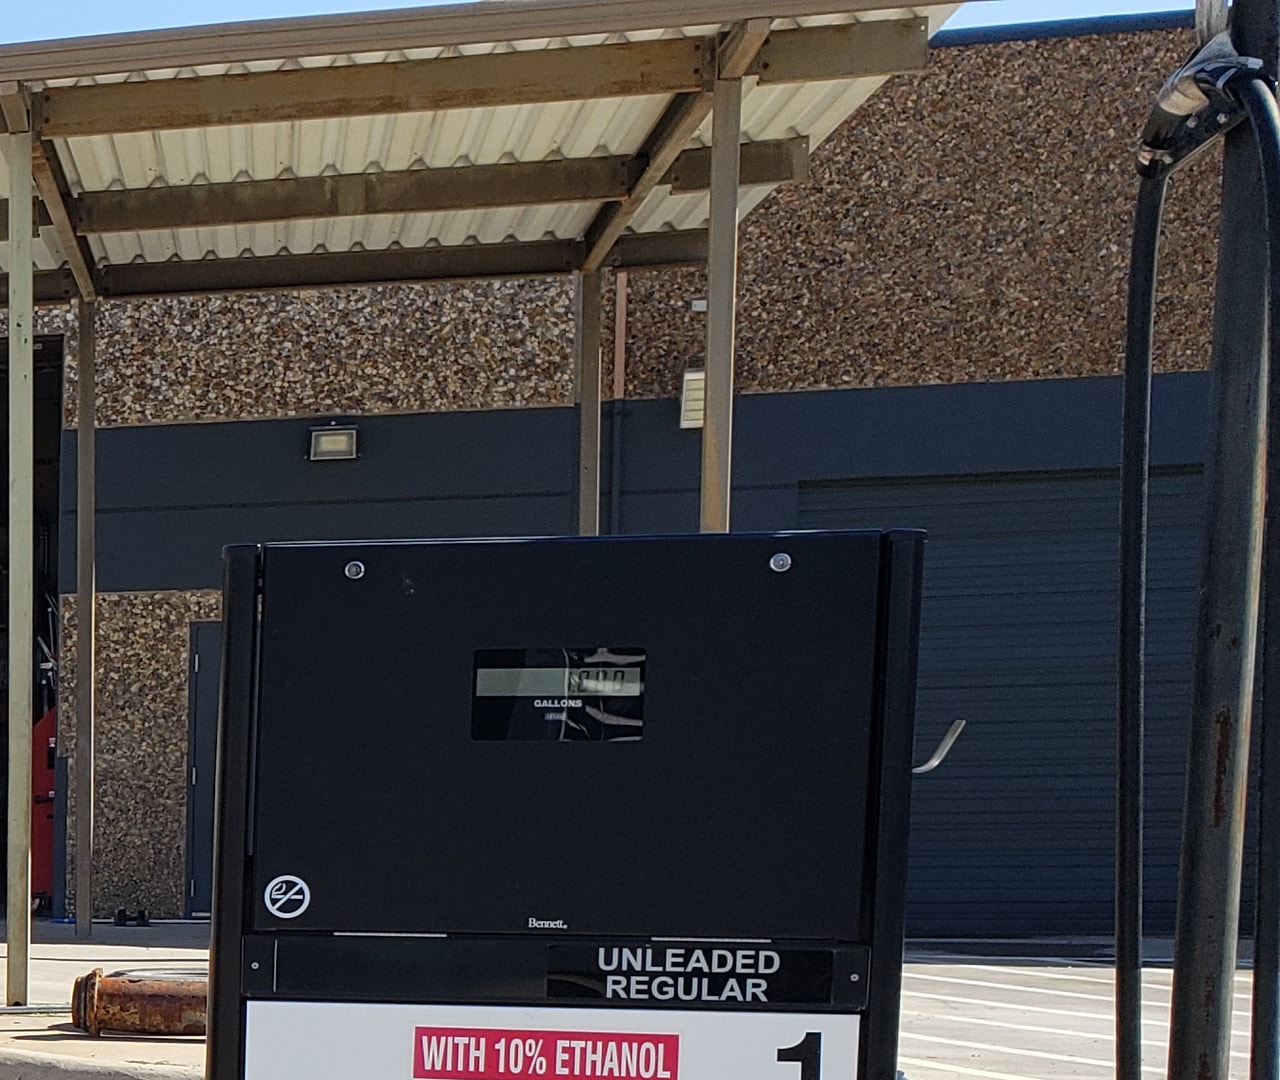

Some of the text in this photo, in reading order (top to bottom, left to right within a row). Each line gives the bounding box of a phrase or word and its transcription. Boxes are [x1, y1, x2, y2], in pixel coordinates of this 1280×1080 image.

[534, 699, 582, 708] GALLONS
[528, 918, 563, 928] Bennett
[597, 947, 780, 974] UNLEADED
[606, 975, 769, 1002] REGULAR
[422, 1035, 671, 1079] WITH 10% ETHANOL
